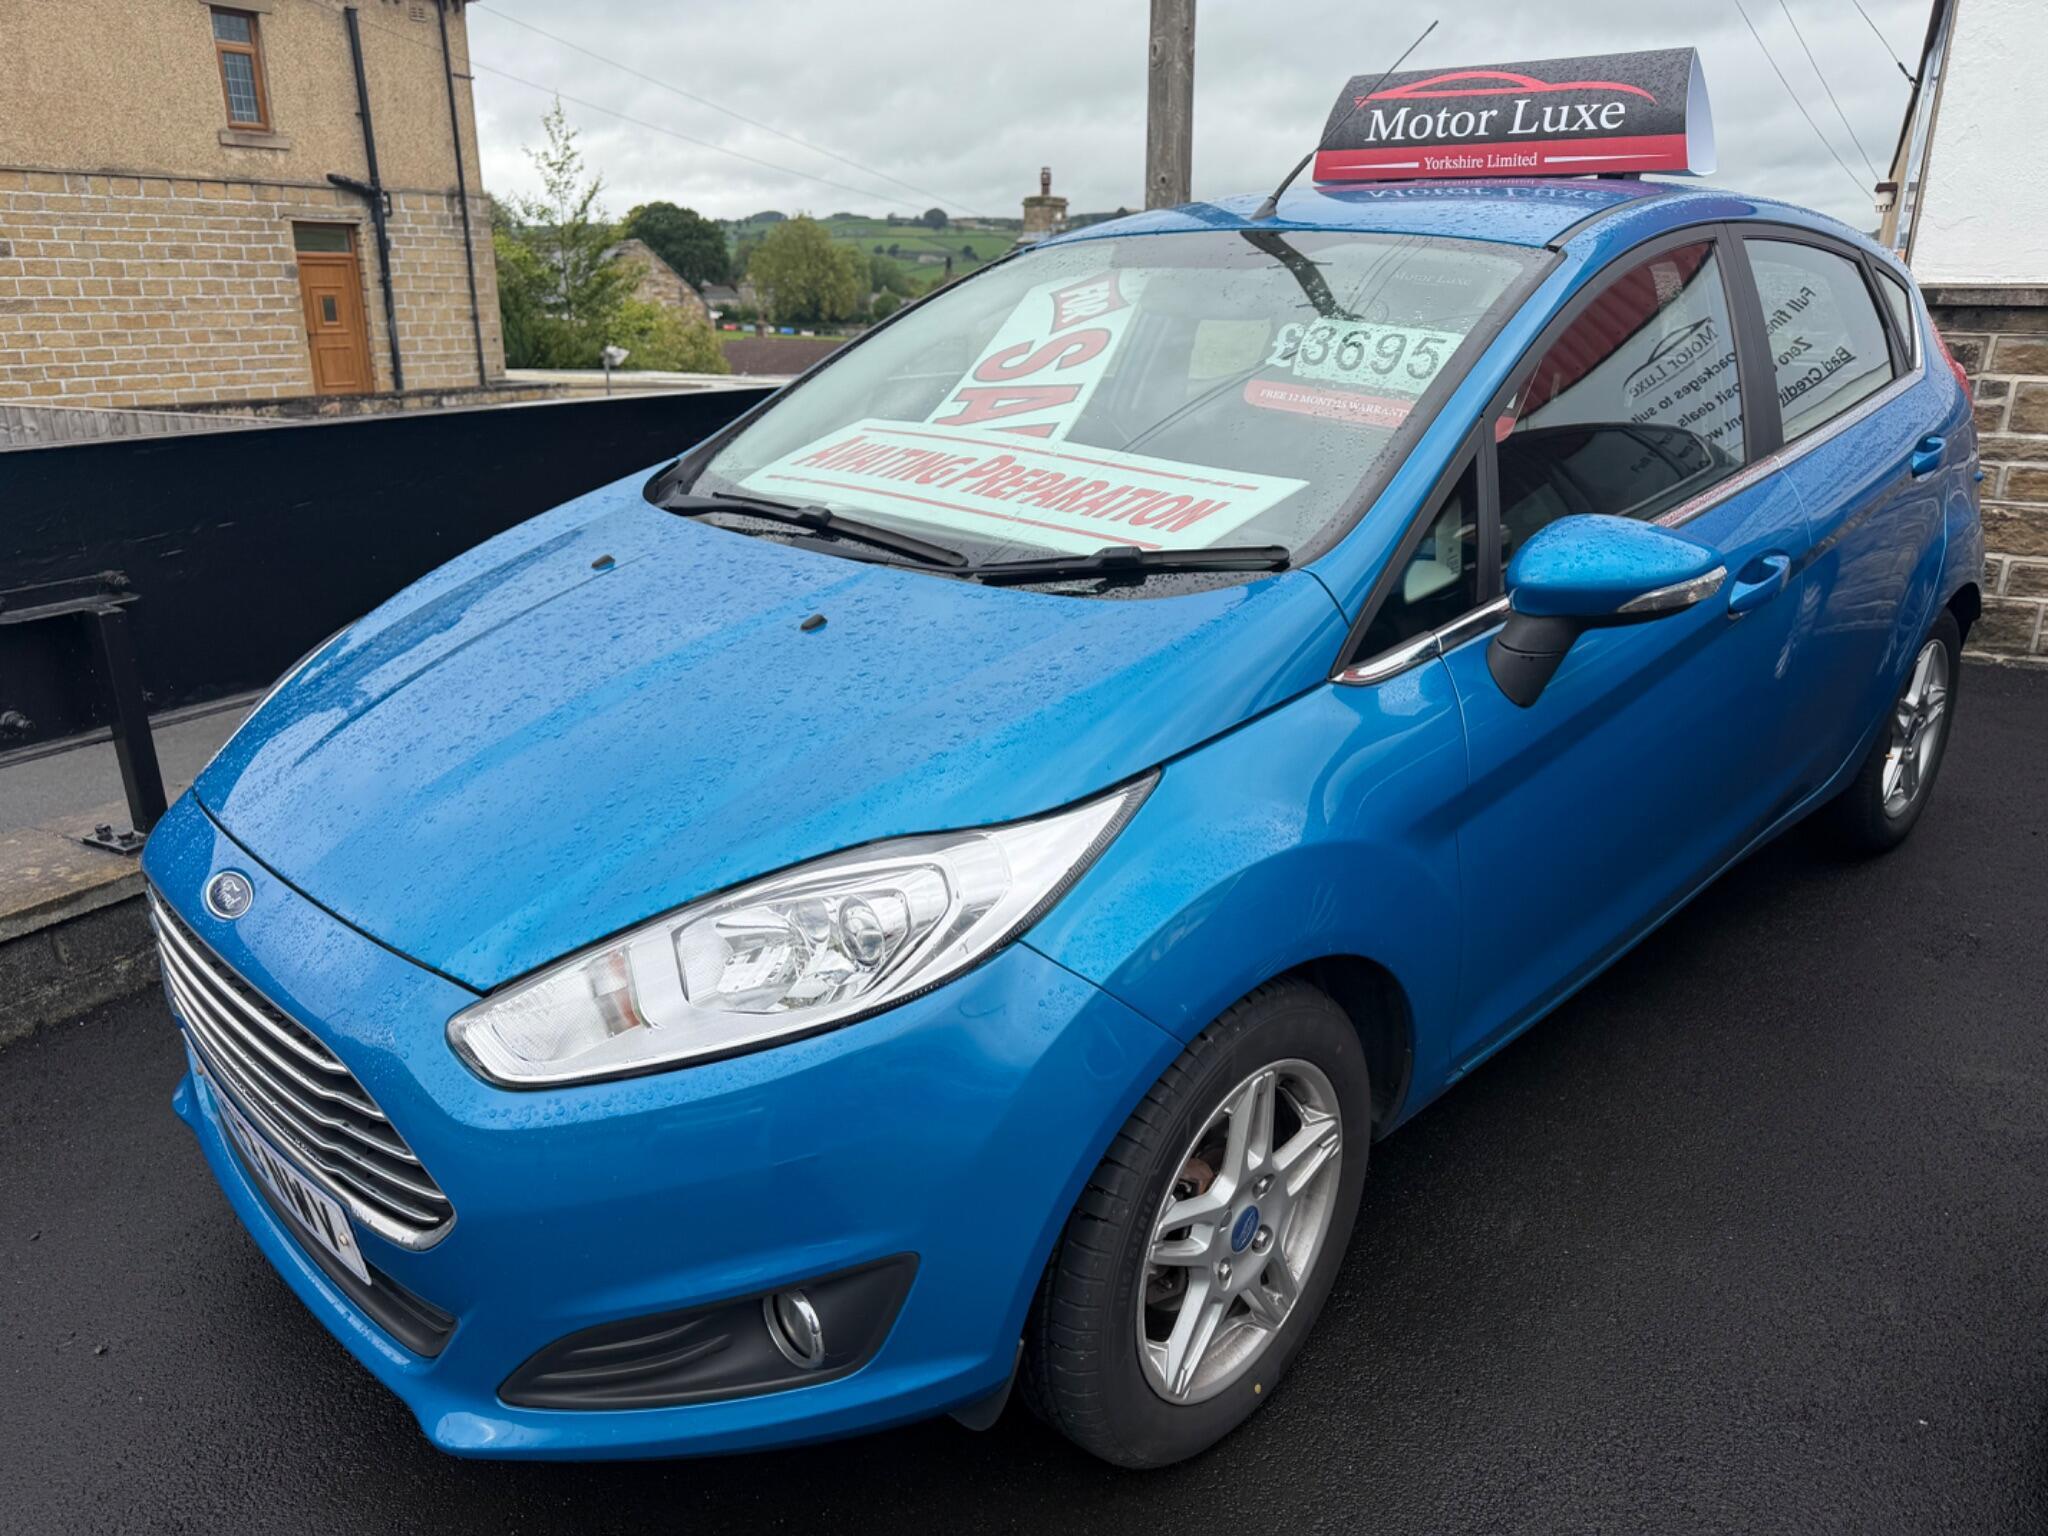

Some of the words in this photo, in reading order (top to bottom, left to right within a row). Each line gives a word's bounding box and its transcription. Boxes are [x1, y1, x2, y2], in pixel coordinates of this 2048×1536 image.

[1364, 107, 1498, 142] Motor
[1507, 99, 1626, 135] Luxe
[1424, 156, 1484, 171] Yorkshire
[1487, 152, 1538, 168] Limited
[1265, 321, 1447, 380] £3695
[933, 328, 1112, 438] SA
[1259, 388, 1288, 401] FREE
[1287, 391, 1299, 402] 12
[1349, 401, 1409, 419] WARRANT
[790, 435, 978, 485] AWAITING
[936, 454, 1231, 533] PREPARATION
